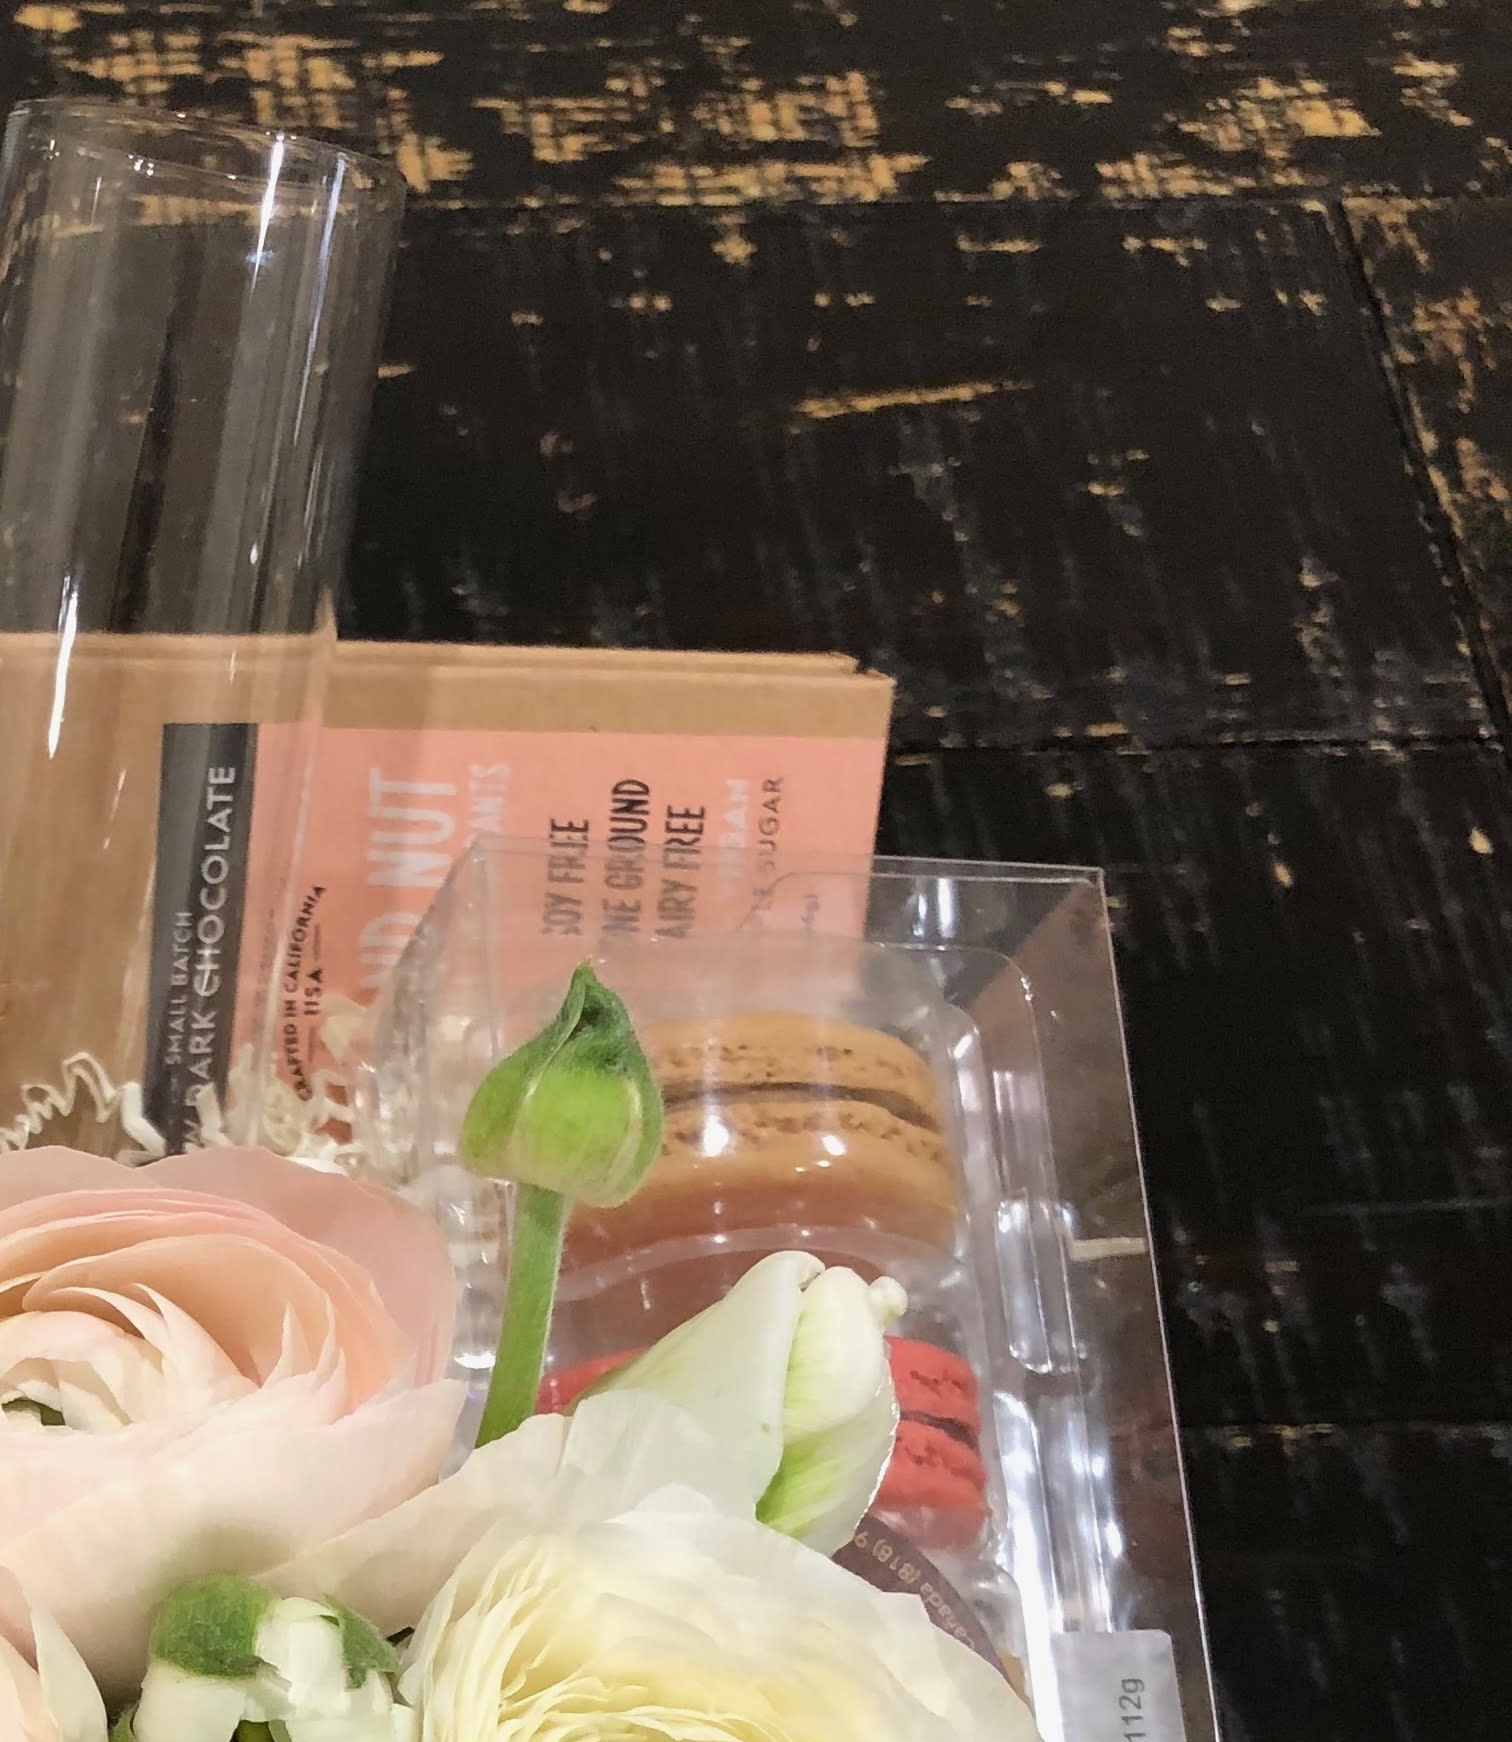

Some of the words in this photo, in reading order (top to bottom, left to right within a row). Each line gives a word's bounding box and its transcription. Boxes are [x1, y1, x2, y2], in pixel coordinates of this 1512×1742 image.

[367, 766, 457, 888] NUT
[604, 778, 651, 891] GROUND
[661, 804, 706, 871] FREE
[193, 767, 236, 998] CHOCOLATE
[170, 911, 193, 986] BATCH
[284, 885, 327, 994] CALIFORNIA
[164, 995, 187, 1065] SMALL
[872, 1538, 921, 1585] (818)
[1118, 1678, 1147, 1742] 112g
